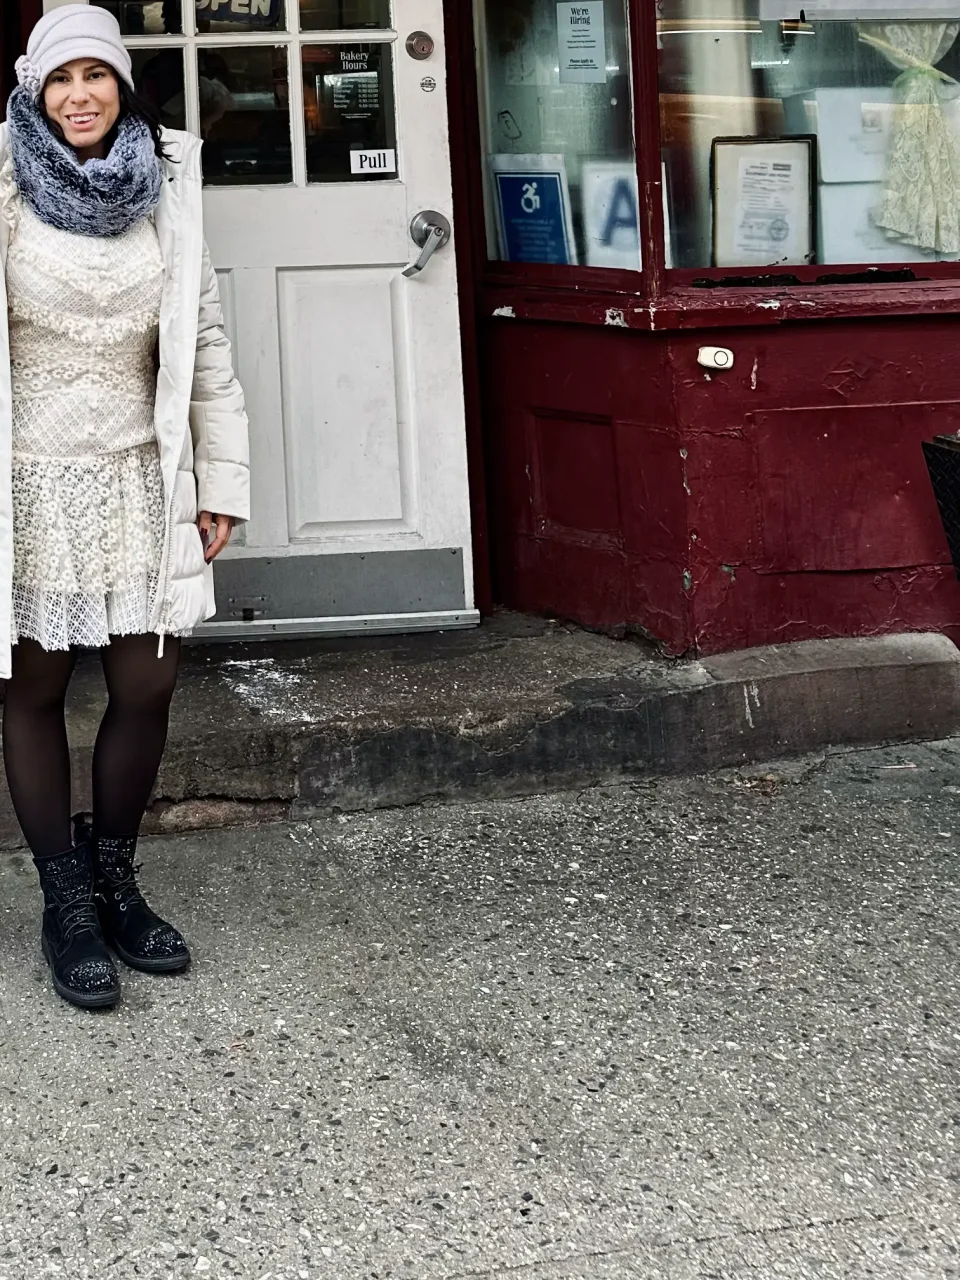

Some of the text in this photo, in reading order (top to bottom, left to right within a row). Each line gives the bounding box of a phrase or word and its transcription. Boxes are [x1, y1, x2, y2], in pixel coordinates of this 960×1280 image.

[570, 7, 590, 16] We're
[569, 16, 591, 26] Hiring
[340, 51, 369, 62] Bakery
[342, 60, 368, 70] Hours
[358, 152, 387, 169] Pull
